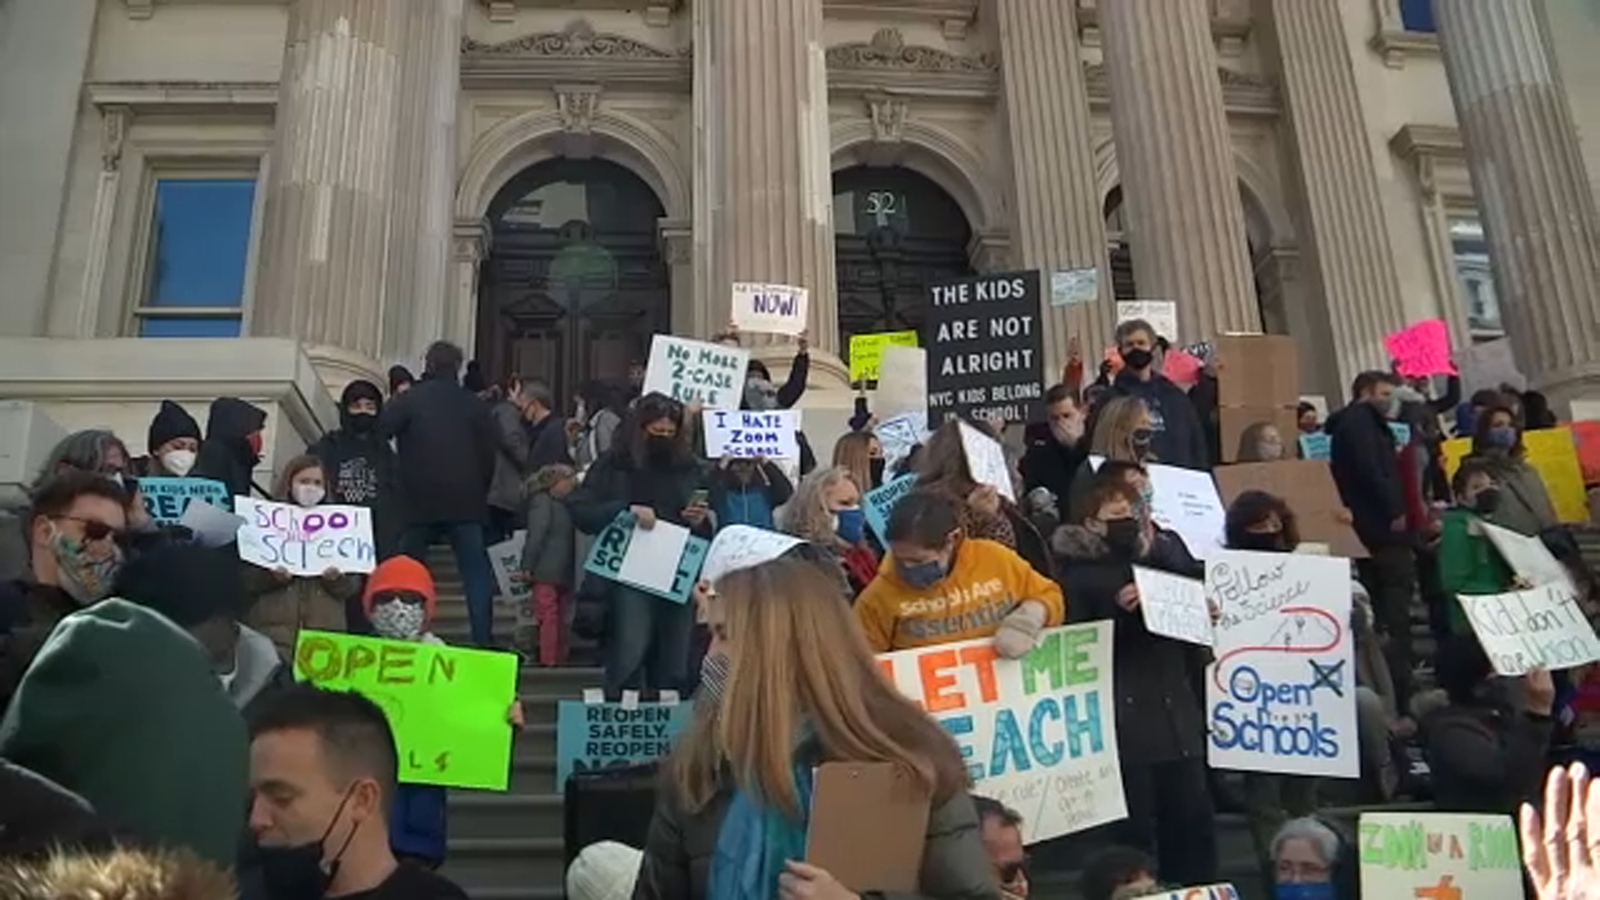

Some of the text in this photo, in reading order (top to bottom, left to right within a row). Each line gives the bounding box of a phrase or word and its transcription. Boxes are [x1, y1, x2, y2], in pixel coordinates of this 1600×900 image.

[866, 191, 896, 213] 52
[932, 279, 1025, 306] THE KIDS
[937, 317, 1032, 342] ARE NOT
[671, 361, 732, 388] 2-CASE
[941, 350, 1033, 376] ALRIGHT
[929, 383, 1041, 408] NYC KIDS BELONG
[715, 412, 783, 428] I HATE
[973, 576, 1003, 597] Are
[298, 637, 456, 684] OPEN
[878, 627, 1099, 712] ET ME
[1229, 665, 1313, 711] Open
[586, 707, 671, 723] REOPEN
[589, 724, 669, 739] SAFELY.
[940, 690, 1104, 780] EACH
[1211, 702, 1339, 758] Schools
[586, 741, 671, 757] REOPEN
